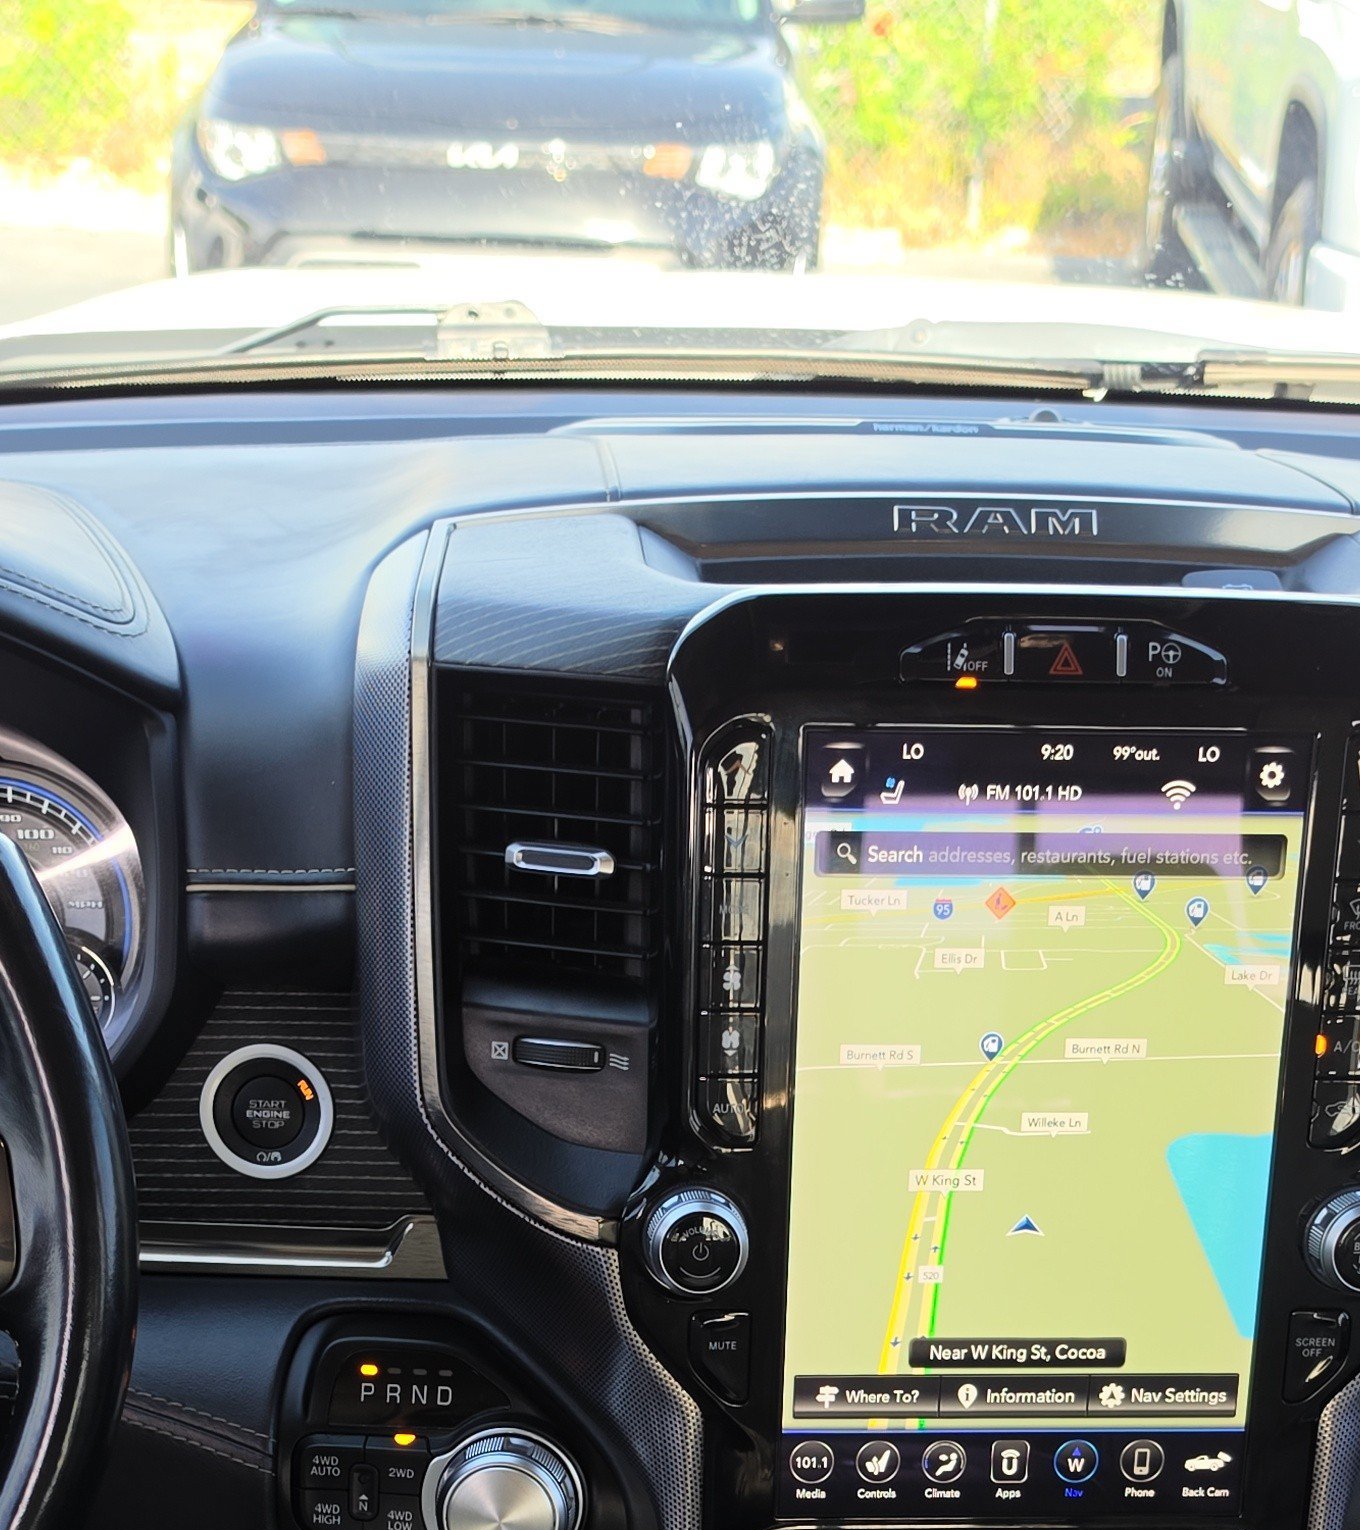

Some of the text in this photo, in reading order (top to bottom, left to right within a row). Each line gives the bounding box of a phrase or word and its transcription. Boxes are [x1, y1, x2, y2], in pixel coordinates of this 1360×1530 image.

[893, 505, 1098, 536] RAM
[967, 661, 988, 671] OFF
[1156, 667, 1173, 678] ON
[902, 743, 925, 760] LO
[1041, 744, 1075, 761] 9:20
[1198, 746, 1220, 763] LO
[986, 784, 1082, 802] FM 101.1 HD
[17, 829, 55, 840] 100
[868, 845, 1253, 866] Search addresses, restaurants, fuel stations etc.
[848, 895, 901, 906] Tucker Ln
[935, 903, 951, 915] 95
[1054, 912, 1079, 923] A Ln
[941, 954, 978, 965] Ellis Dr
[1231, 970, 1273, 981] Lake Dr
[1072, 1044, 1141, 1055] Burnett Rd N
[1333, 1040, 1360, 1054] A/C
[846, 1050, 914, 1061] Burnett Rd S
[249, 1099, 286, 1109] START
[712, 1102, 745, 1114] AUTO
[246, 1110, 290, 1119] ENGINE
[252, 1120, 285, 1129] STOP
[1028, 1117, 1082, 1128] Willeke Ln
[915, 1175, 977, 1188] W King St
[709, 1341, 737, 1351] MUTE
[1295, 1337, 1336, 1347] SCREEN
[929, 1344, 1107, 1363] Near W King St, Cocoa
[1302, 1348, 1322, 1358] OFF
[360, 1382, 453, 1406] P R N D
[845, 1389, 920, 1404] Where To?
[987, 1388, 1075, 1404] Information
[1131, 1388, 1227, 1406] Nav Settings
[312, 1455, 339, 1467] 4WD
[796, 1456, 828, 1469] 101.1
[1067, 1457, 1085, 1473] W
[310, 1465, 340, 1477] AUTO
[388, 1467, 415, 1480] 2WD
[796, 1488, 827, 1500] Media
[856, 1488, 897, 1499] Controls
[924, 1488, 961, 1499] Climate
[995, 1488, 1021, 1501] Apps
[1064, 1488, 1084, 1498] Nav
[1124, 1487, 1155, 1498] Phone
[1182, 1487, 1230, 1498] Back Cam
[314, 1503, 340, 1515] 4WD
[358, 1501, 368, 1512] N
[312, 1513, 341, 1525] HIGH
[386, 1510, 413, 1522] 4WD
